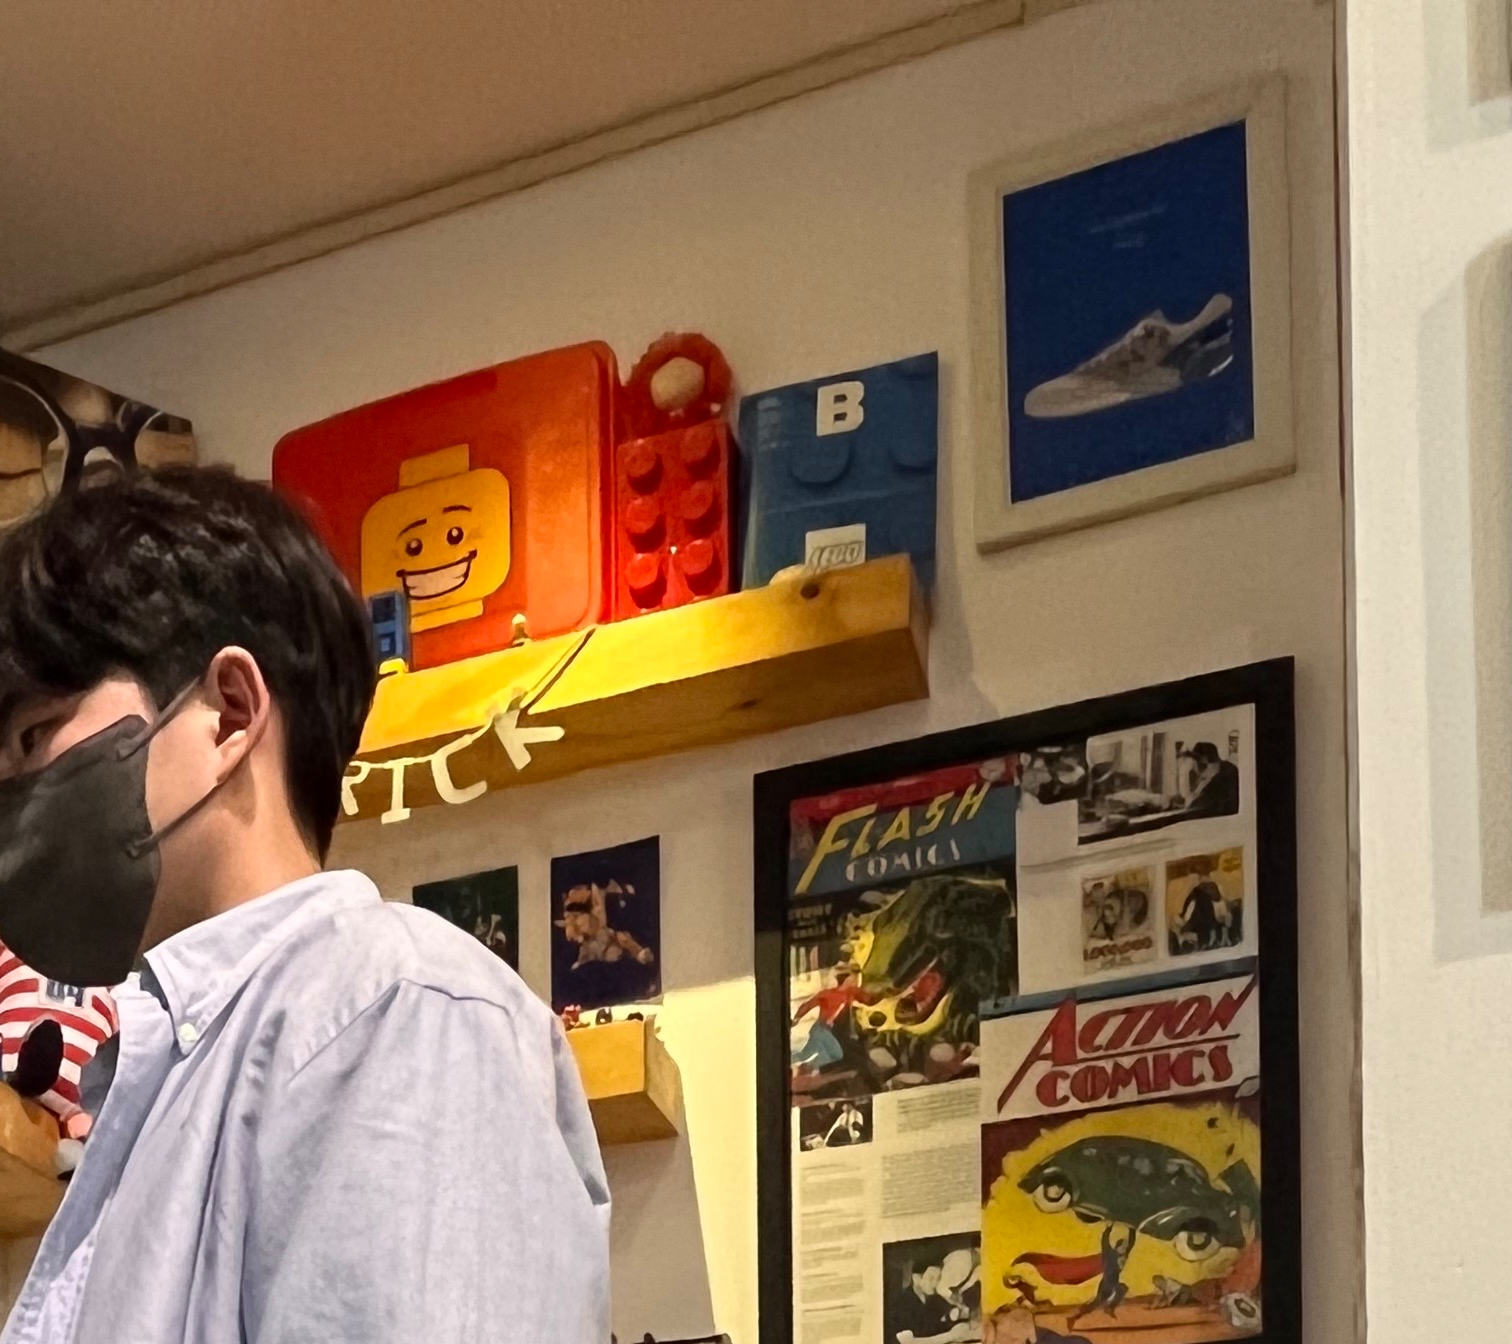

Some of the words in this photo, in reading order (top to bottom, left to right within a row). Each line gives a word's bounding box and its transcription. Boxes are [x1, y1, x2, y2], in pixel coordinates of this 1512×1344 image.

[816, 380, 865, 437] B
[794, 782, 992, 897] FLASH
[997, 972, 1258, 1114] ACTION
[1036, 1044, 1234, 1107] COMICS
